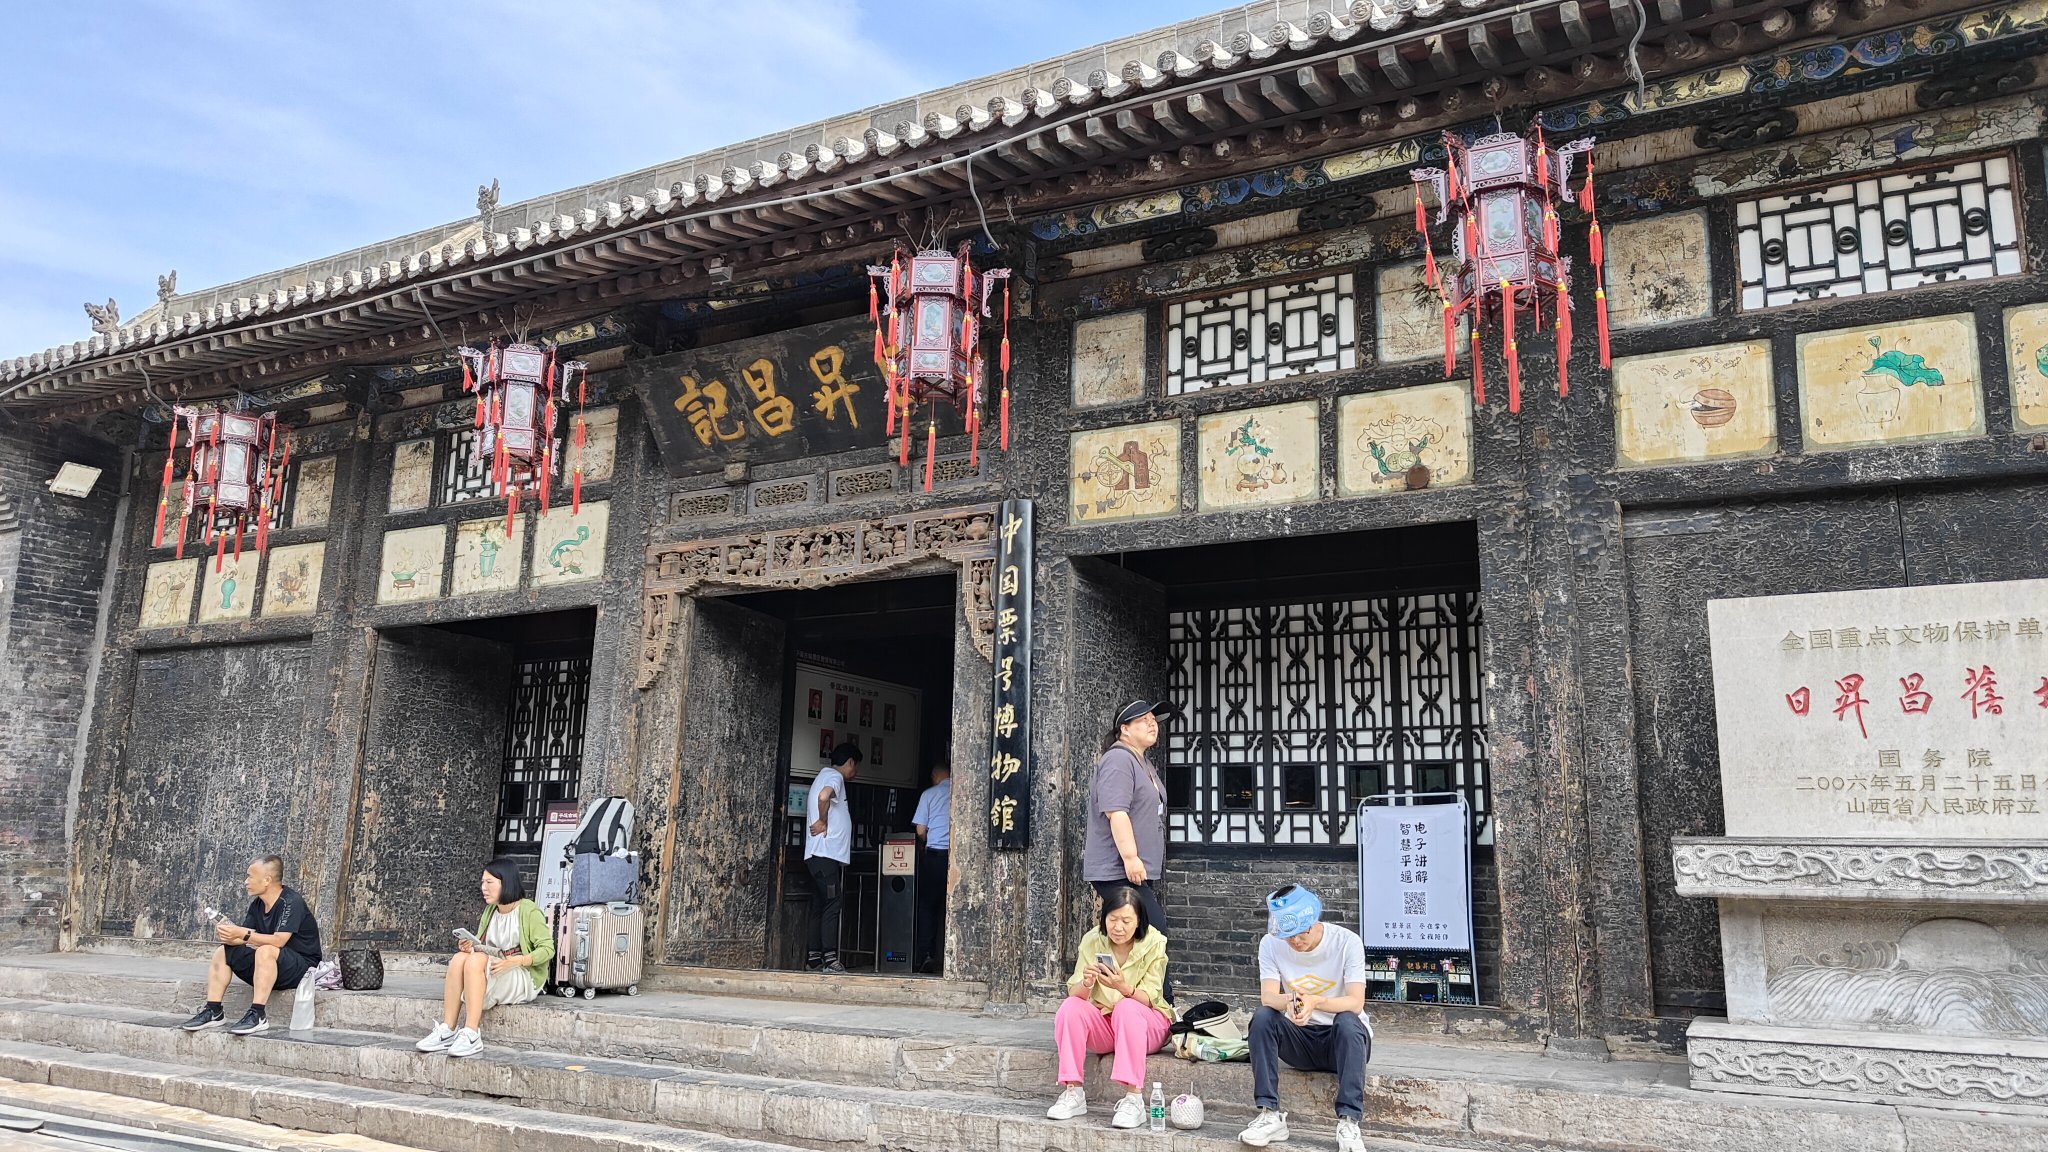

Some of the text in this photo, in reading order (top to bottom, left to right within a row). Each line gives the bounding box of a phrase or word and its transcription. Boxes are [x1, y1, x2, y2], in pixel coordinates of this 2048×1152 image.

[1780, 617, 2048, 651] 全国重点文物保护单
[1878, 748, 1993, 769] 国务院
[1796, 774, 2048, 792] 二〇〇六年五月二十五日
[1847, 797, 2040, 816] 山西省人民政府立
[1415, 822, 1428, 883] 电子讲解
